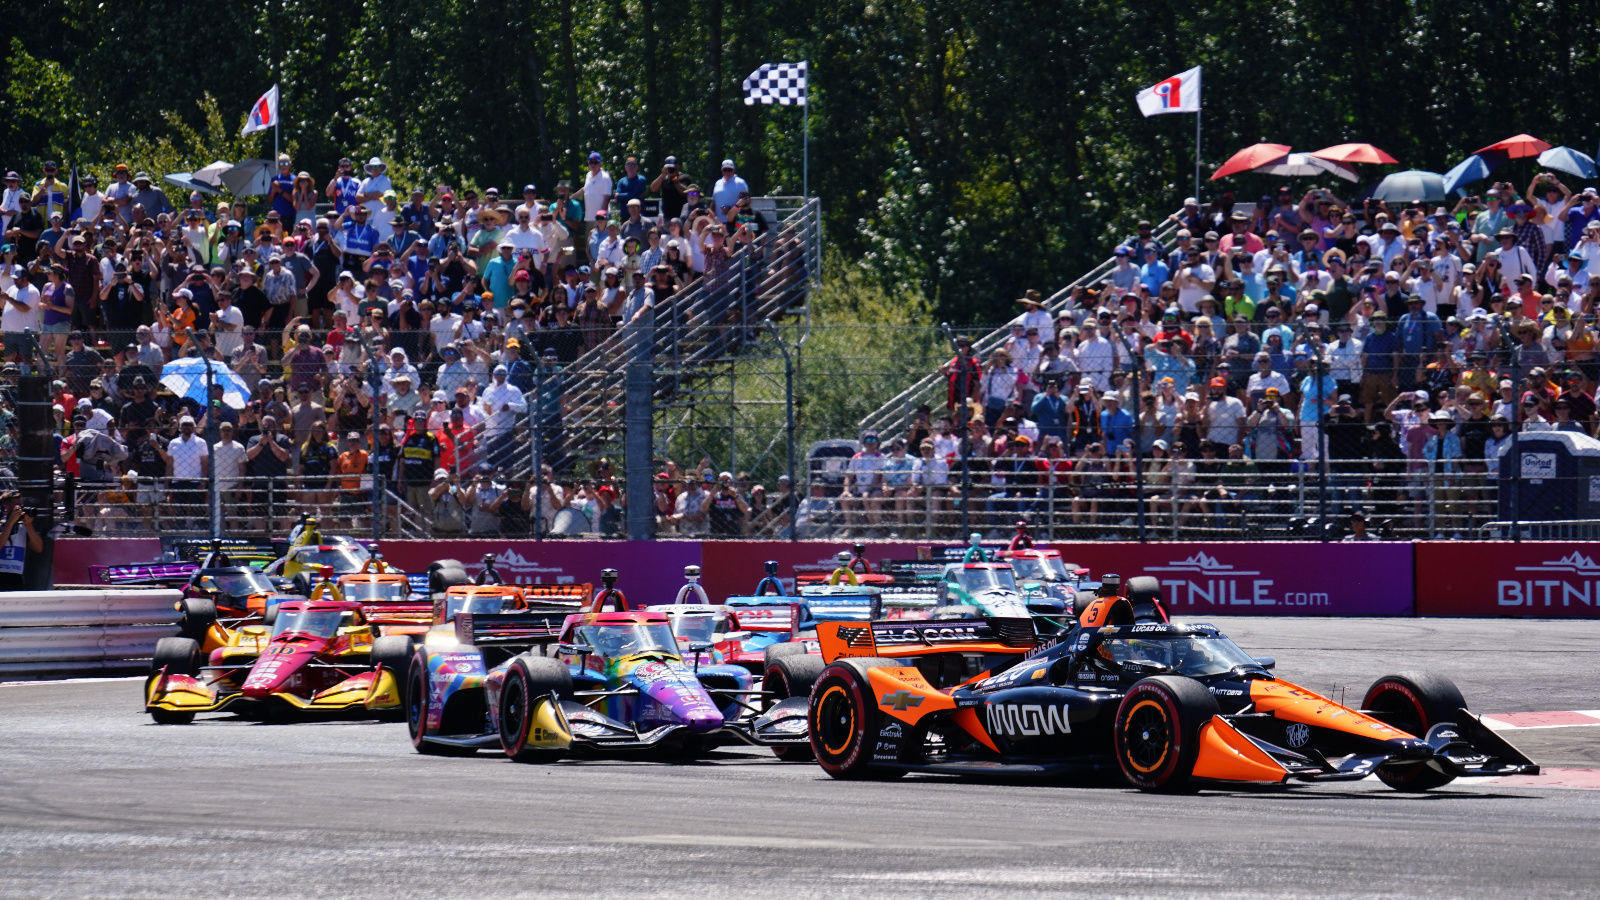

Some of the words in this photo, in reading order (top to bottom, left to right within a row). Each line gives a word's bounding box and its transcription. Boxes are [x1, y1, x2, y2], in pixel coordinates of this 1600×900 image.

[1525, 458, 1552, 466] United
[1162, 580, 1329, 606] TNILE.com
[1087, 601, 1102, 623] 5
[873, 628, 980, 642] ELO.COM
[1131, 625, 1155, 633] LUCAS
[1024, 642, 1046, 660] LUCAS
[1047, 637, 1057, 649] OIL
[1078, 672, 1096, 680] mission
[1138, 684, 1169, 702] Firestone
[1384, 683, 1416, 702] Firestone
[986, 704, 1071, 736] ARROW
[879, 729, 902, 738] Electrolit
